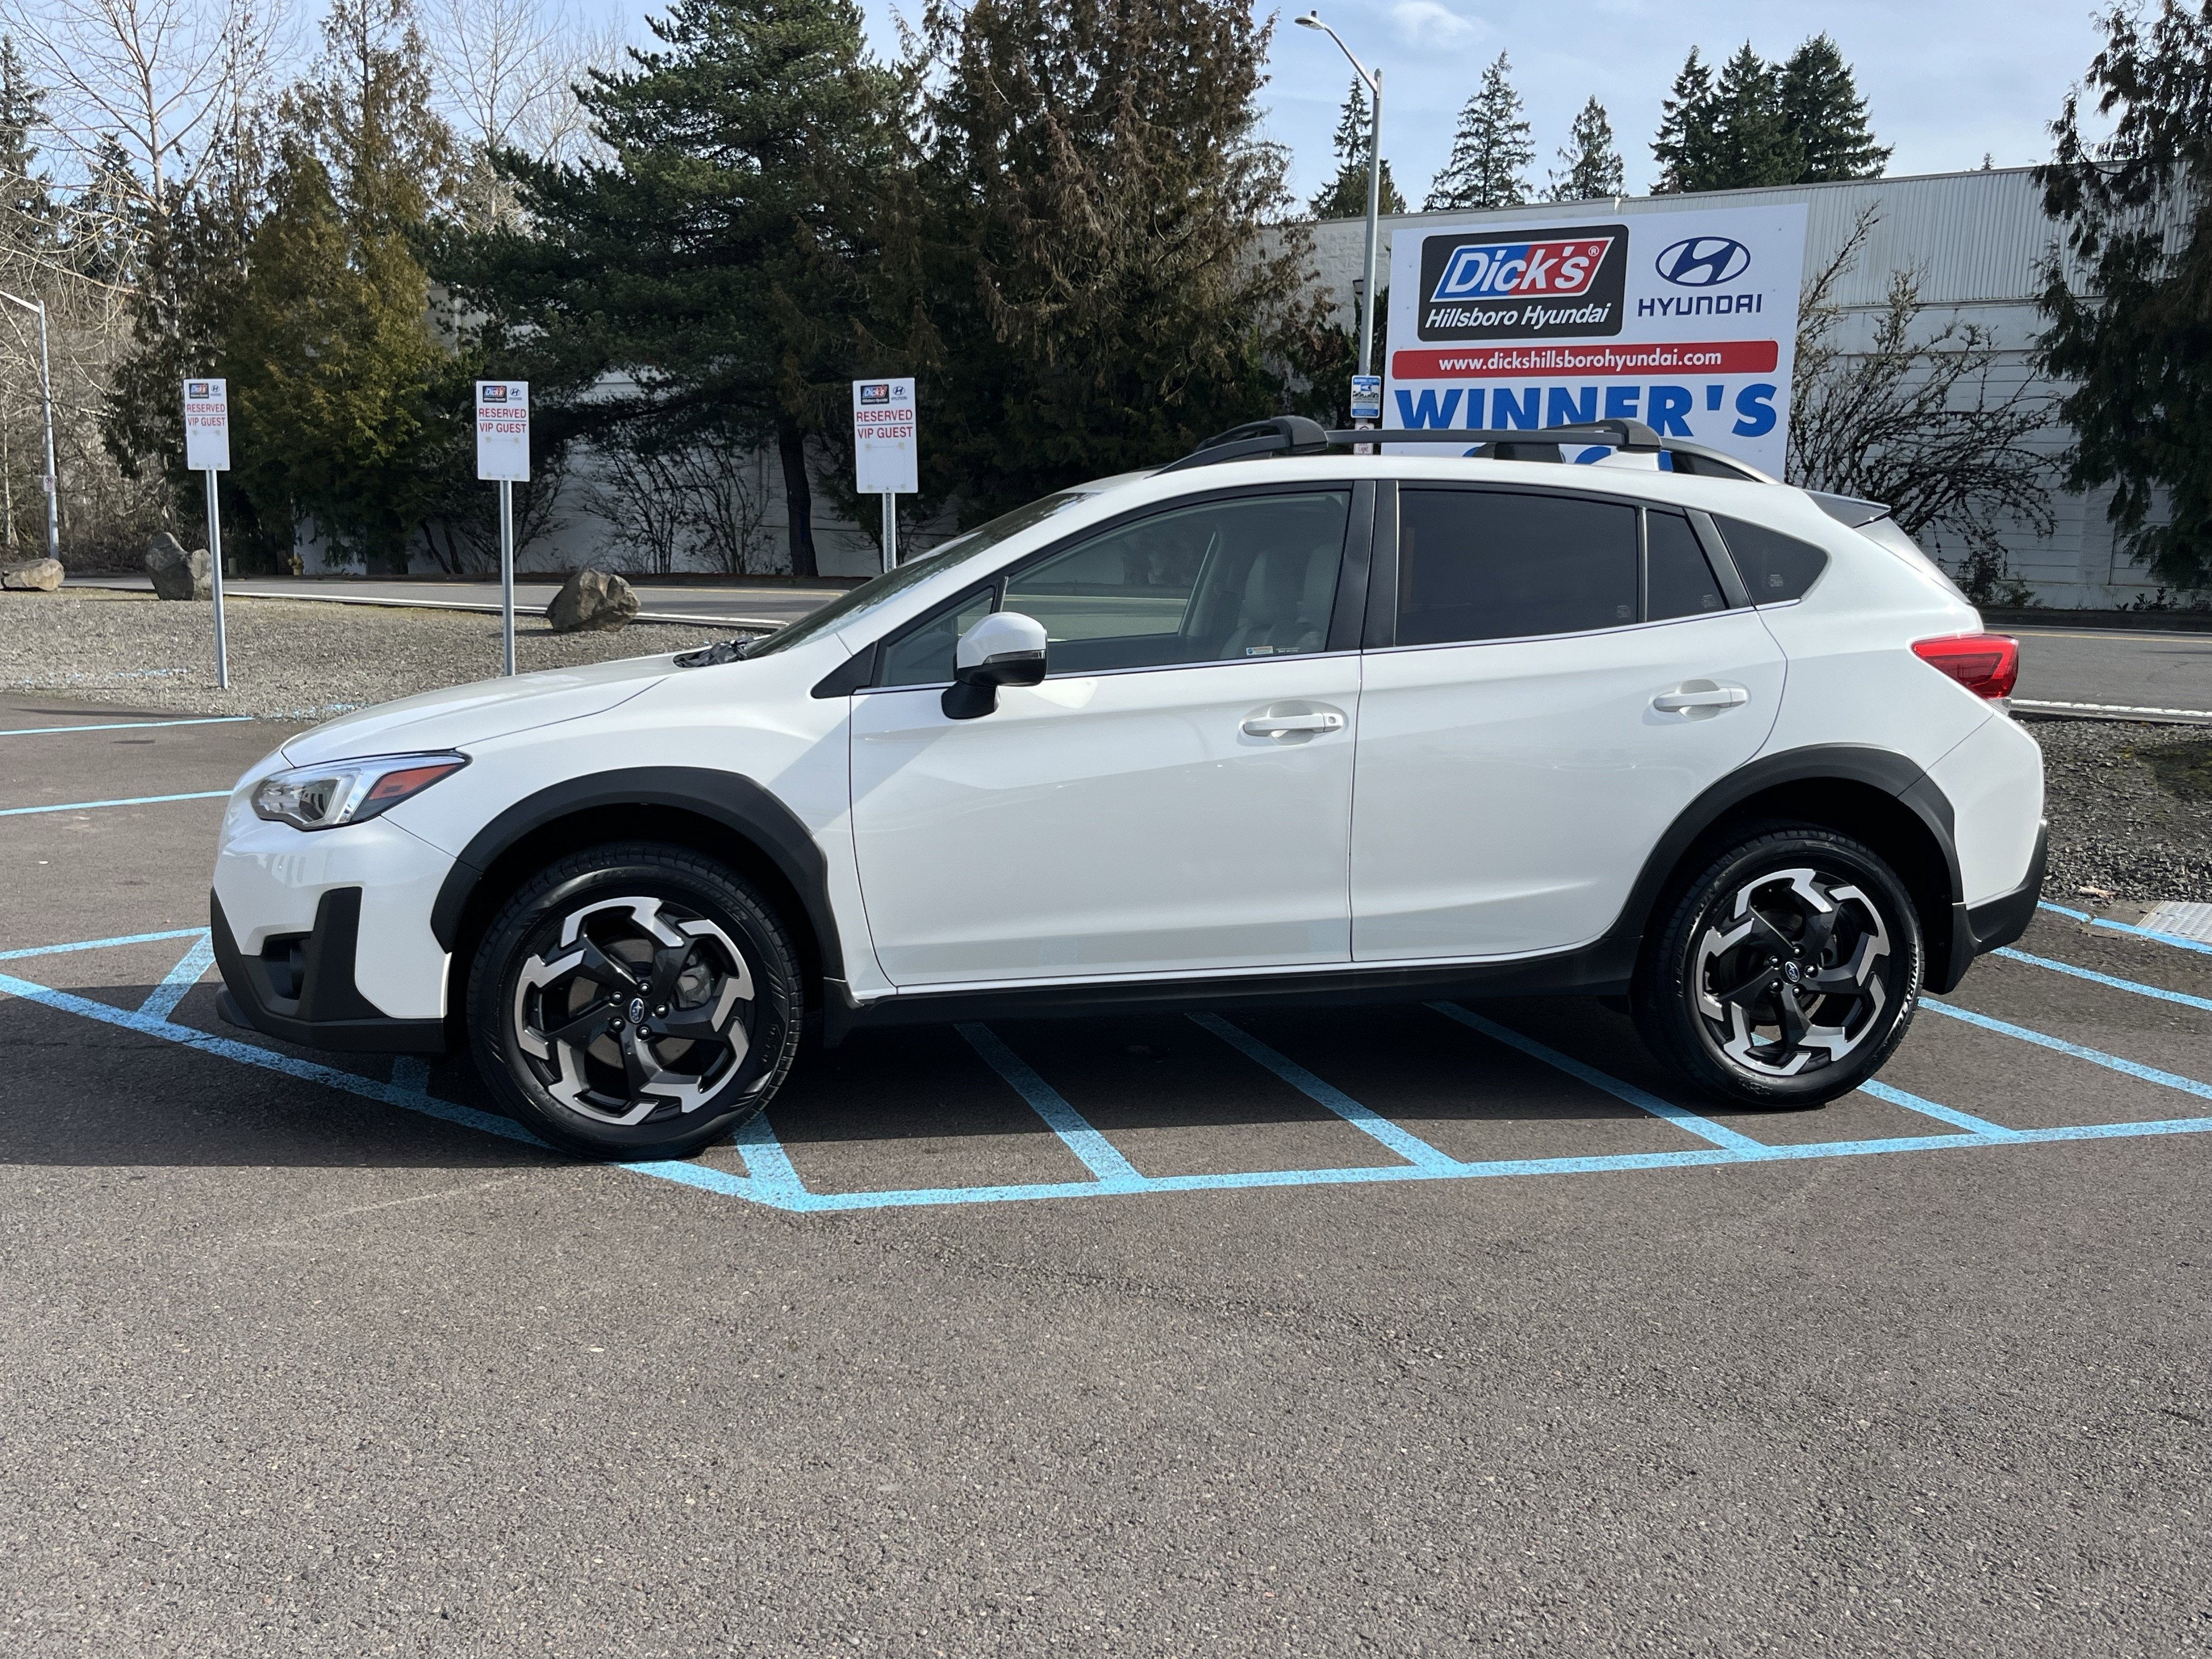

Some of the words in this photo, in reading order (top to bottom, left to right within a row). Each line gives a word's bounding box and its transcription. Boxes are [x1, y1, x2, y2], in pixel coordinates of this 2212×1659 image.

[1638, 294, 1762, 317] HYUNDAI
[1425, 307, 1519, 329] Hillsboro
[1521, 303, 1612, 330] Hyundai
[1438, 348, 1722, 372] www.dickshillsborohyundai.com
[187, 404, 225, 413] RESERVED
[479, 408, 527, 418] RESERVED
[1394, 384, 1778, 438] WINNER'S
[188, 417, 199, 426] VIP
[201, 417, 225, 426] GUEST
[856, 409, 913, 422] RESERVED
[479, 422, 493, 432] VIP
[496, 423, 527, 433] GUEST
[857, 427, 873, 439] VIP
[877, 426, 913, 438] GUEST
